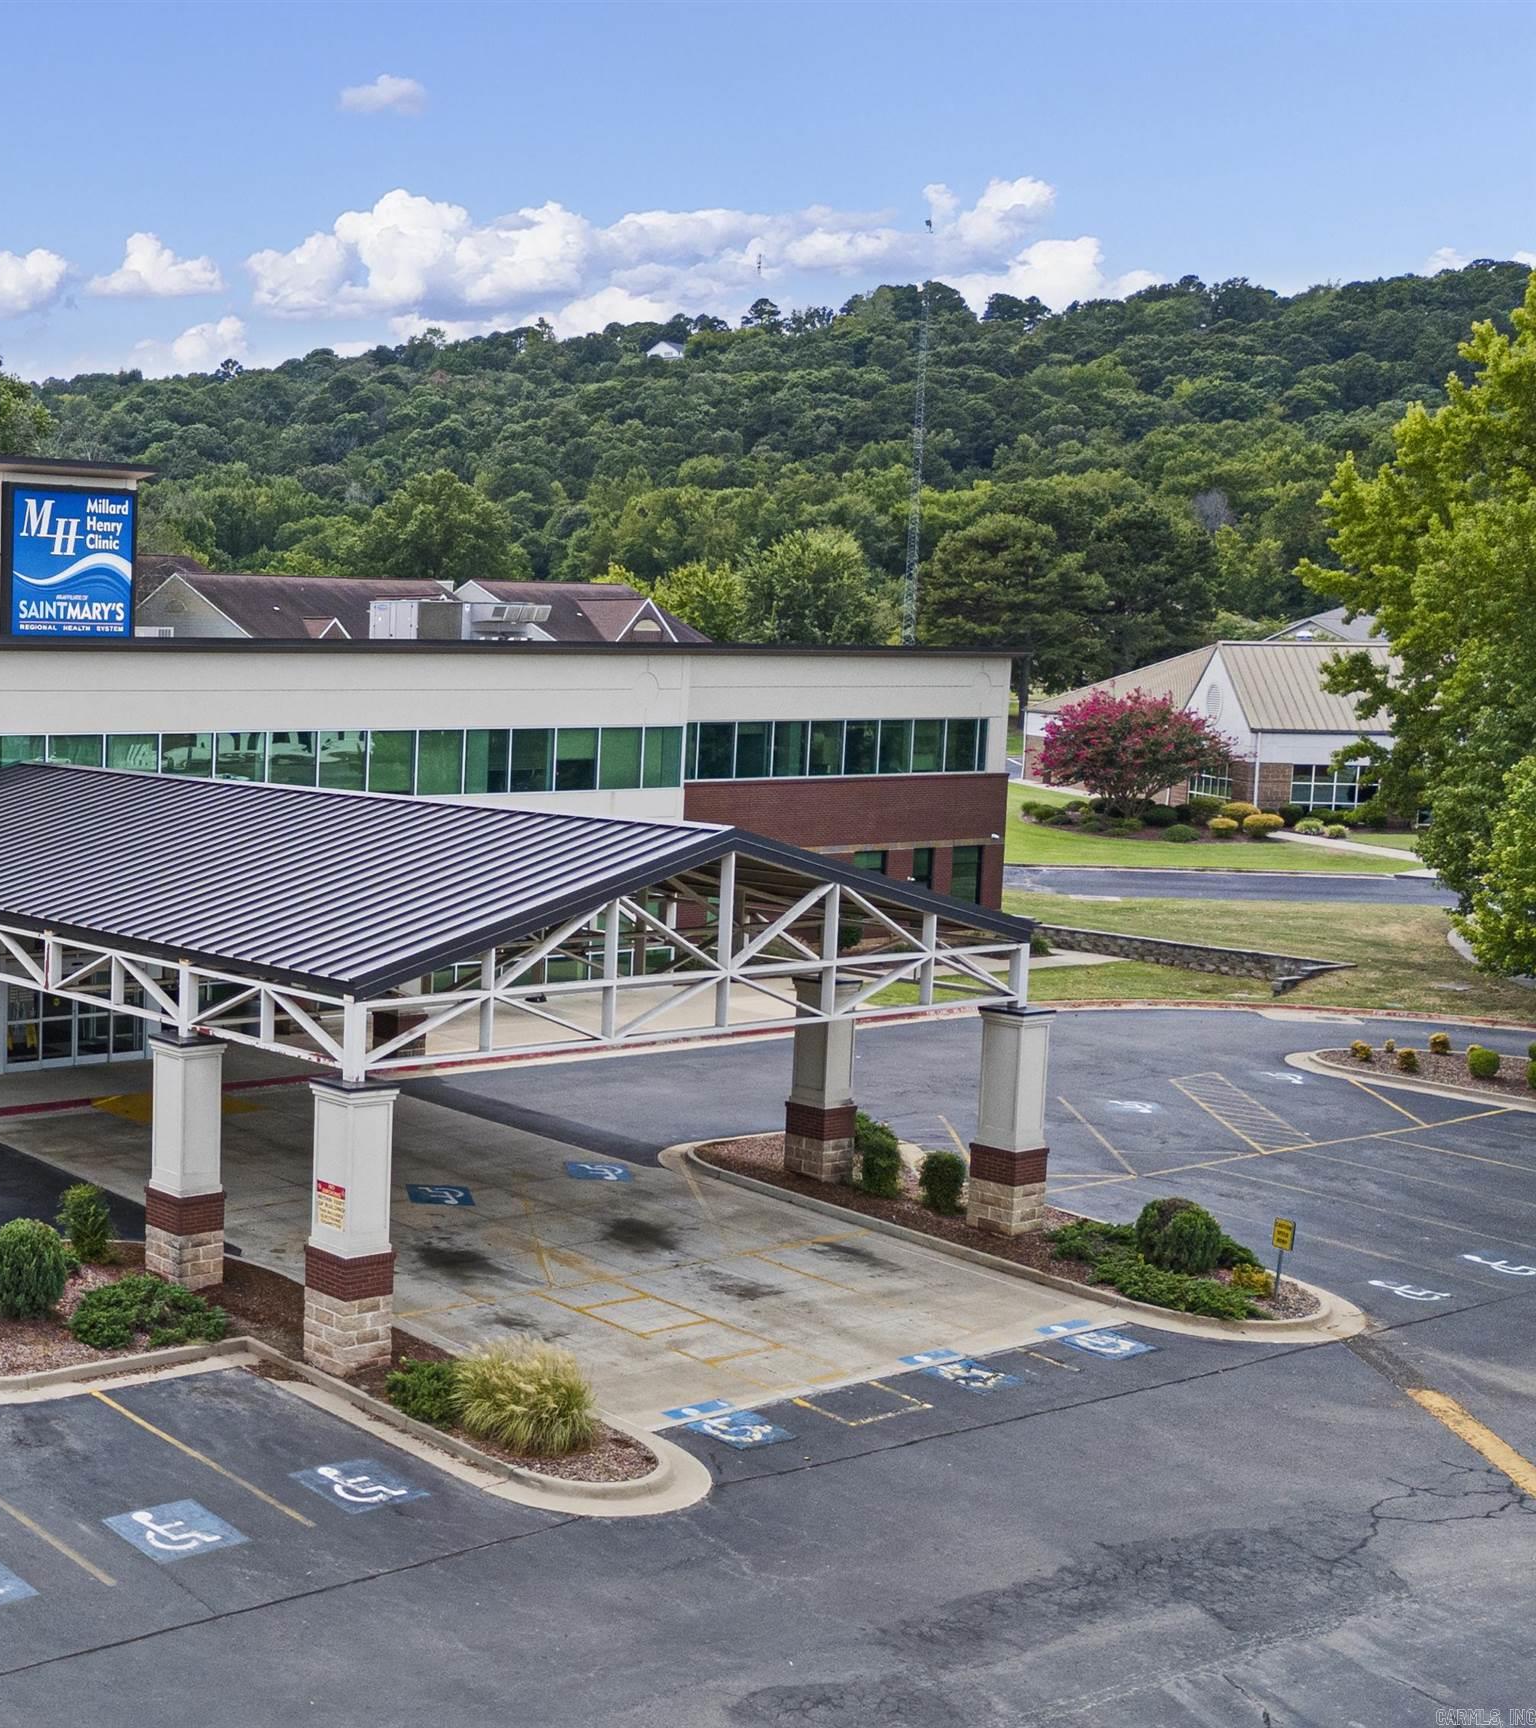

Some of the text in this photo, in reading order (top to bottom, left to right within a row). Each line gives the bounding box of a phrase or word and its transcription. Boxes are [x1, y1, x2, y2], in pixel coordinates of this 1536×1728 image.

[86, 498, 129, 516] Millard
[86, 516, 123, 536] Henry
[85, 533, 120, 550] Clinic
[19, 623, 57, 631] REGIONAL
